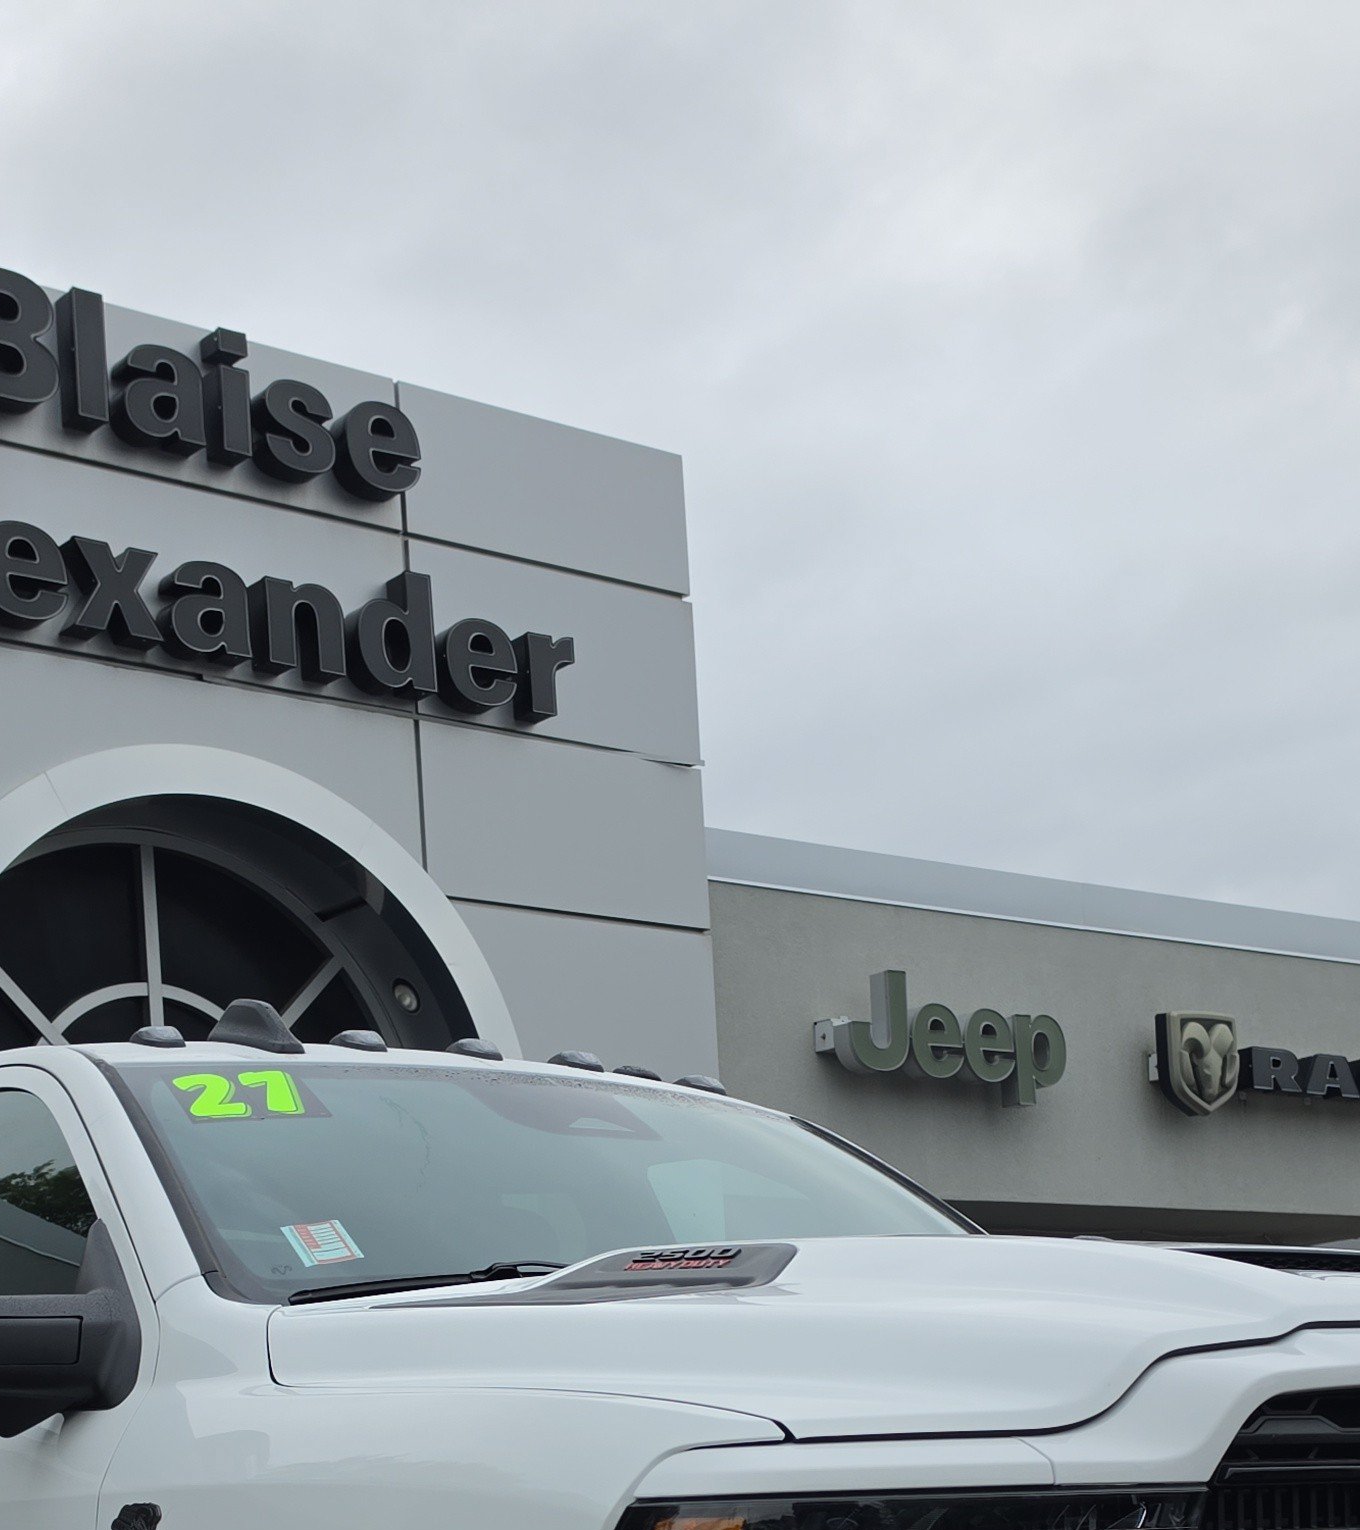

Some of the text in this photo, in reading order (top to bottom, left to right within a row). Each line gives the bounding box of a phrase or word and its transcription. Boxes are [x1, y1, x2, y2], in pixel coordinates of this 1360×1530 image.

[836, 969, 1067, 1106] Jeep
[172, 1070, 305, 1118] 27
[631, 1247, 742, 1263] 2500
[679, 1258, 731, 1270] DUTY
